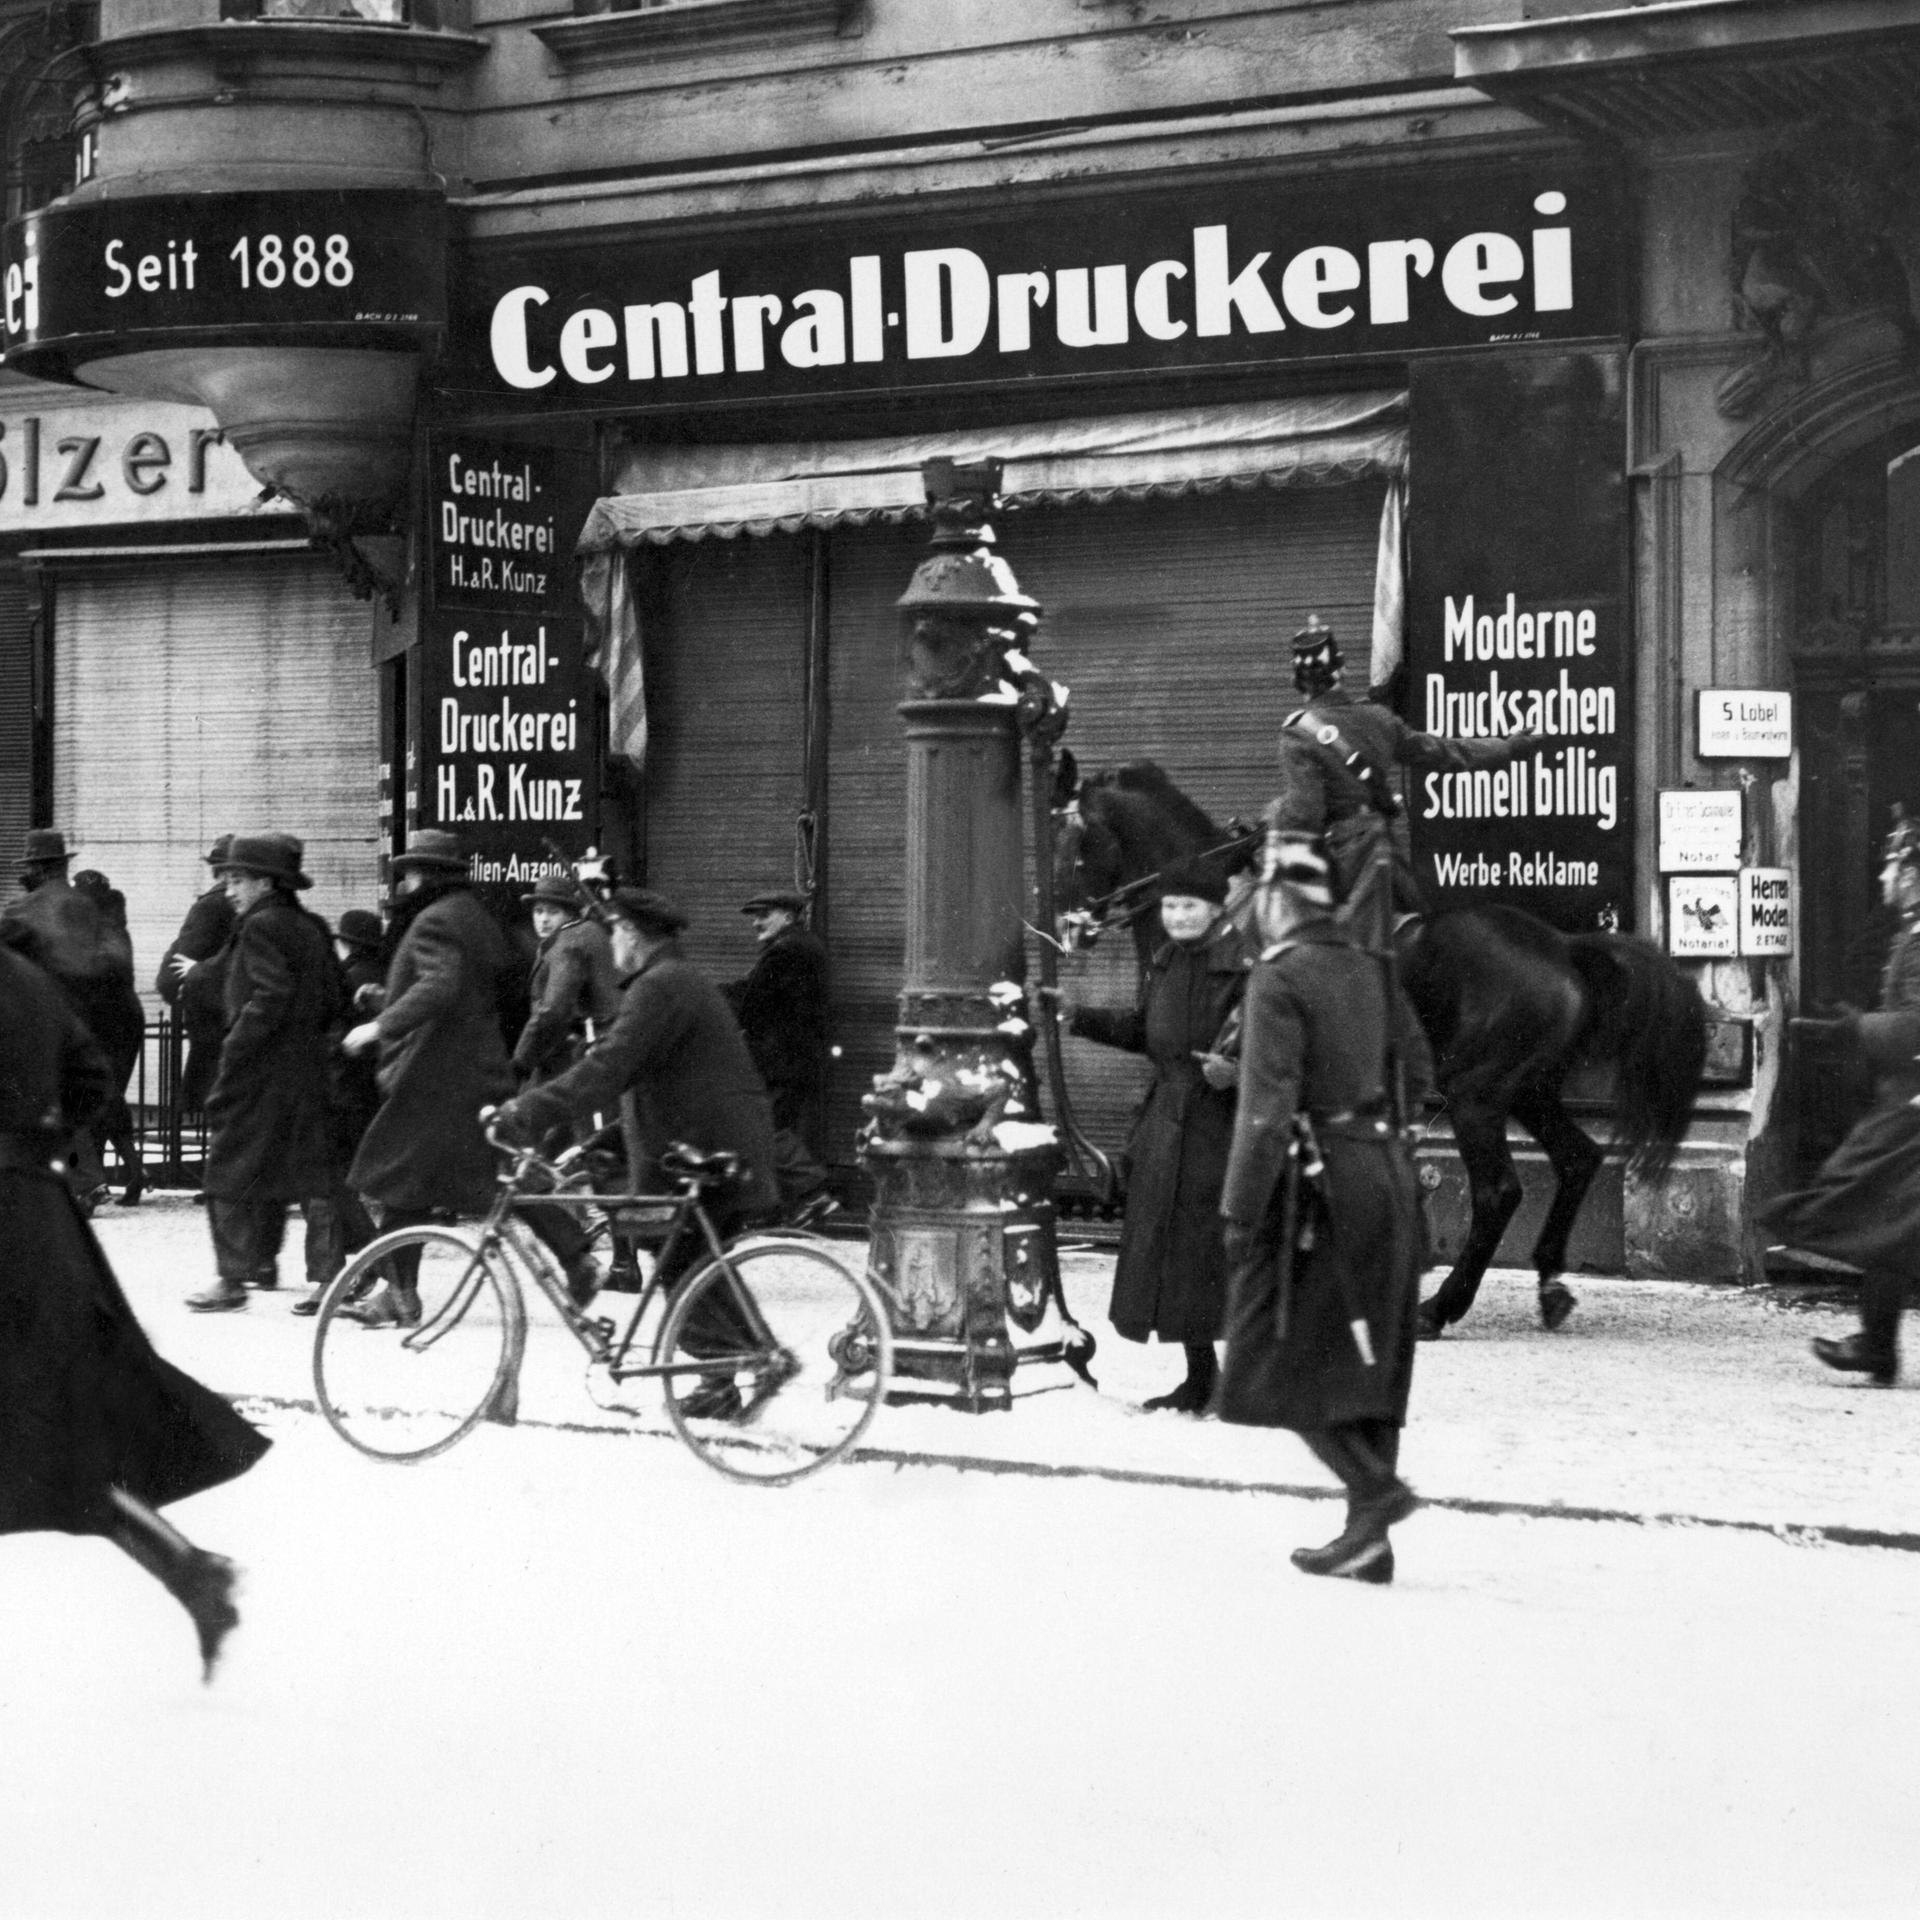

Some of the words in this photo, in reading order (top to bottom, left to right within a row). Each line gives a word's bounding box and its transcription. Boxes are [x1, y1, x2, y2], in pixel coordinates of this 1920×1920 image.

[105, 239, 198, 297] Seit
[230, 234, 354, 289] 1888
[0, 417, 225, 506] lzer
[450, 454, 541, 502] Central-
[443, 501, 553, 553] Druckerei
[502, 560, 547, 594] Kunz
[1445, 593, 1596, 661] Moderne
[452, 627, 559, 688] Central-
[442, 696, 577, 753] Druckerei
[1426, 669, 1616, 739] Drucksachen
[508, 763, 583, 821] Kunz
[1534, 747, 1617, 830] billig
[1679, 851, 1719, 863] Notar
[1751, 875, 1790, 900] Herren
[1751, 904, 1790, 928] Moden
[1764, 934, 1789, 947] ETAGE
[1678, 938, 1731, 951] Notariat
